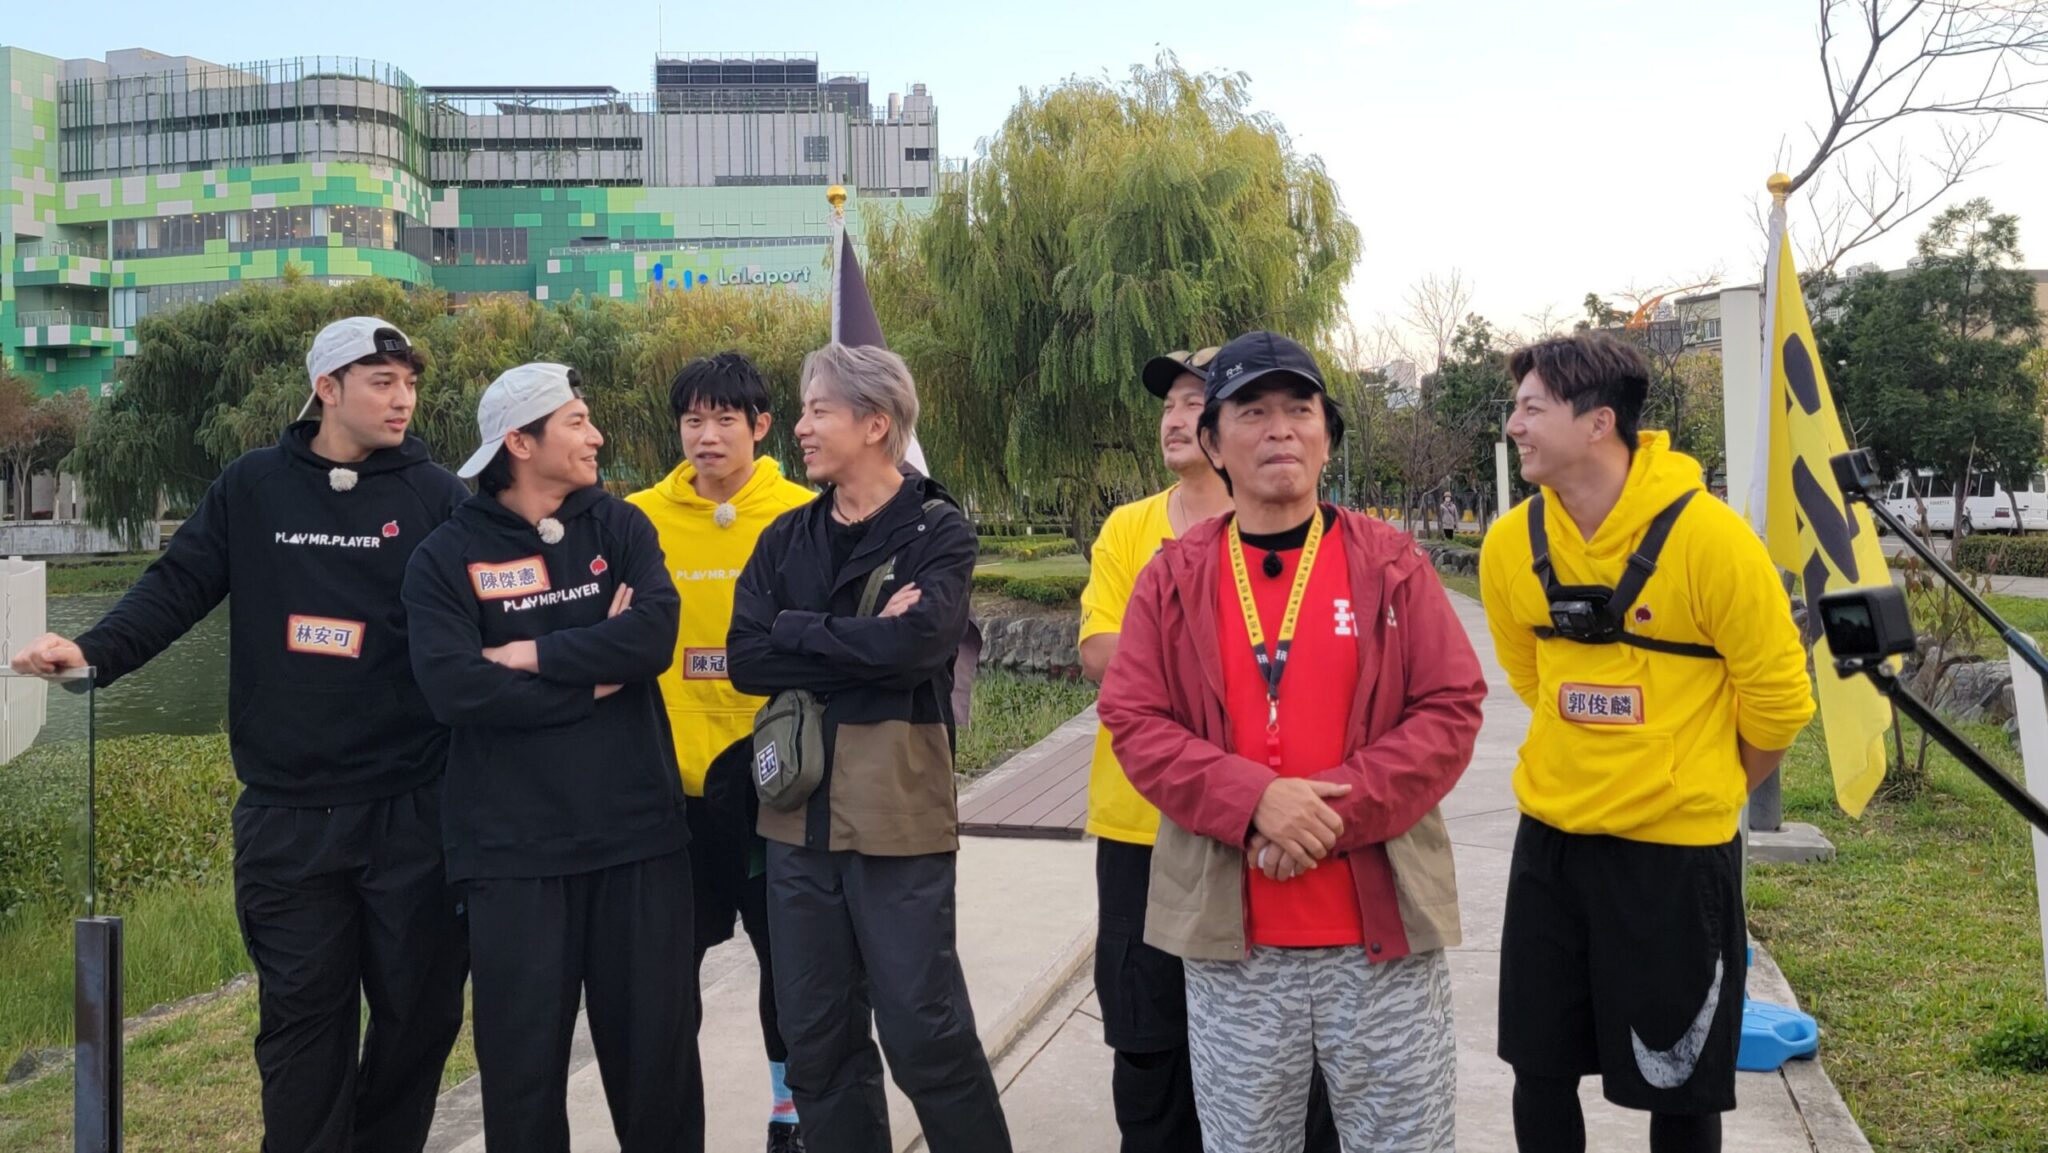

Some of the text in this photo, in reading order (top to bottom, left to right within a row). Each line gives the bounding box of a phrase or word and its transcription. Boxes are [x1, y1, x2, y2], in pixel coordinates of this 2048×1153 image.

[718, 266, 811, 286] LaLaport
[480, 567, 537, 590] 陳傑憲
[296, 624, 352, 647] 林安可
[1568, 692, 1632, 716] 郭俊麟
